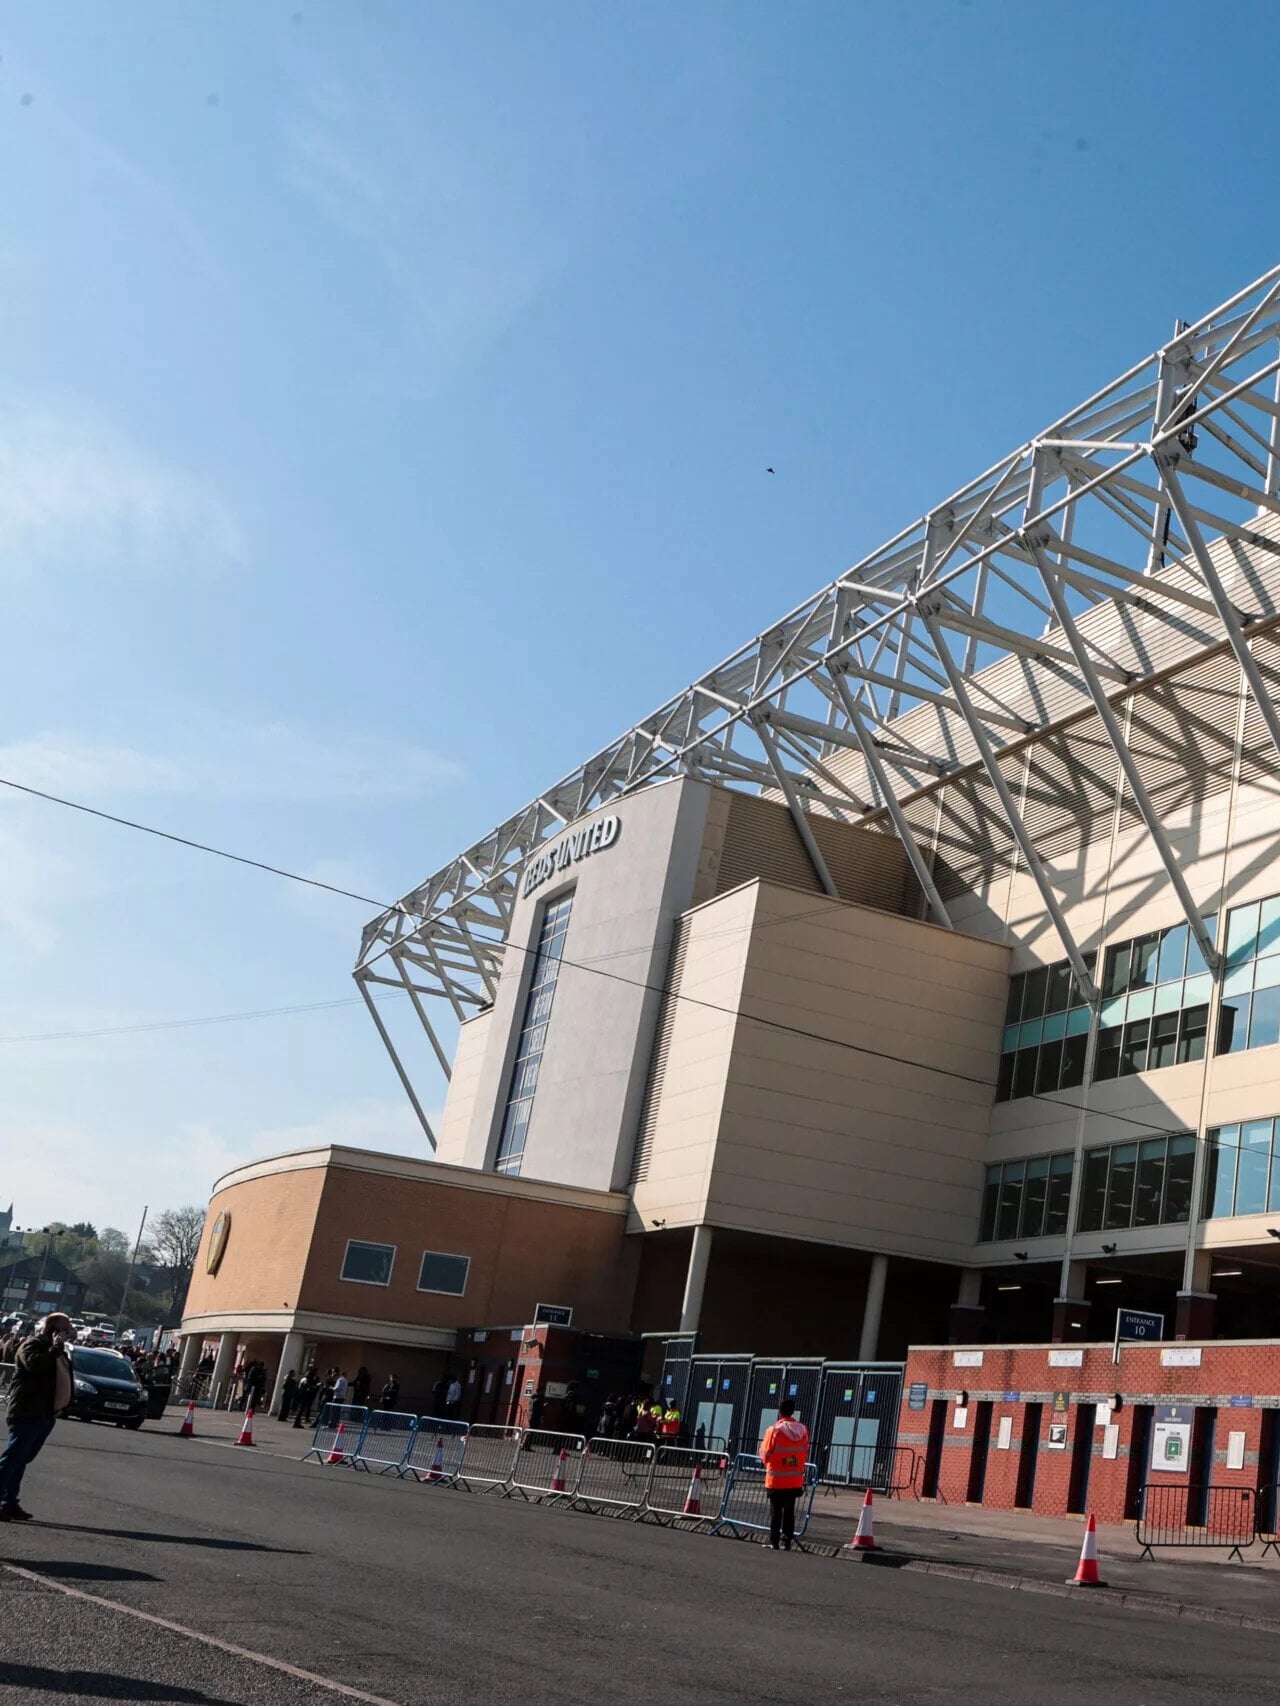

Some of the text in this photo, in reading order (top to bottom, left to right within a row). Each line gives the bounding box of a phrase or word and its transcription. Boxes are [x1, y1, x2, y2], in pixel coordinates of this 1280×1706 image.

[556, 815, 621, 872] UNITED
[1126, 1316, 1155, 1327] ENTRANCE
[1135, 1325, 1146, 1336] 10
